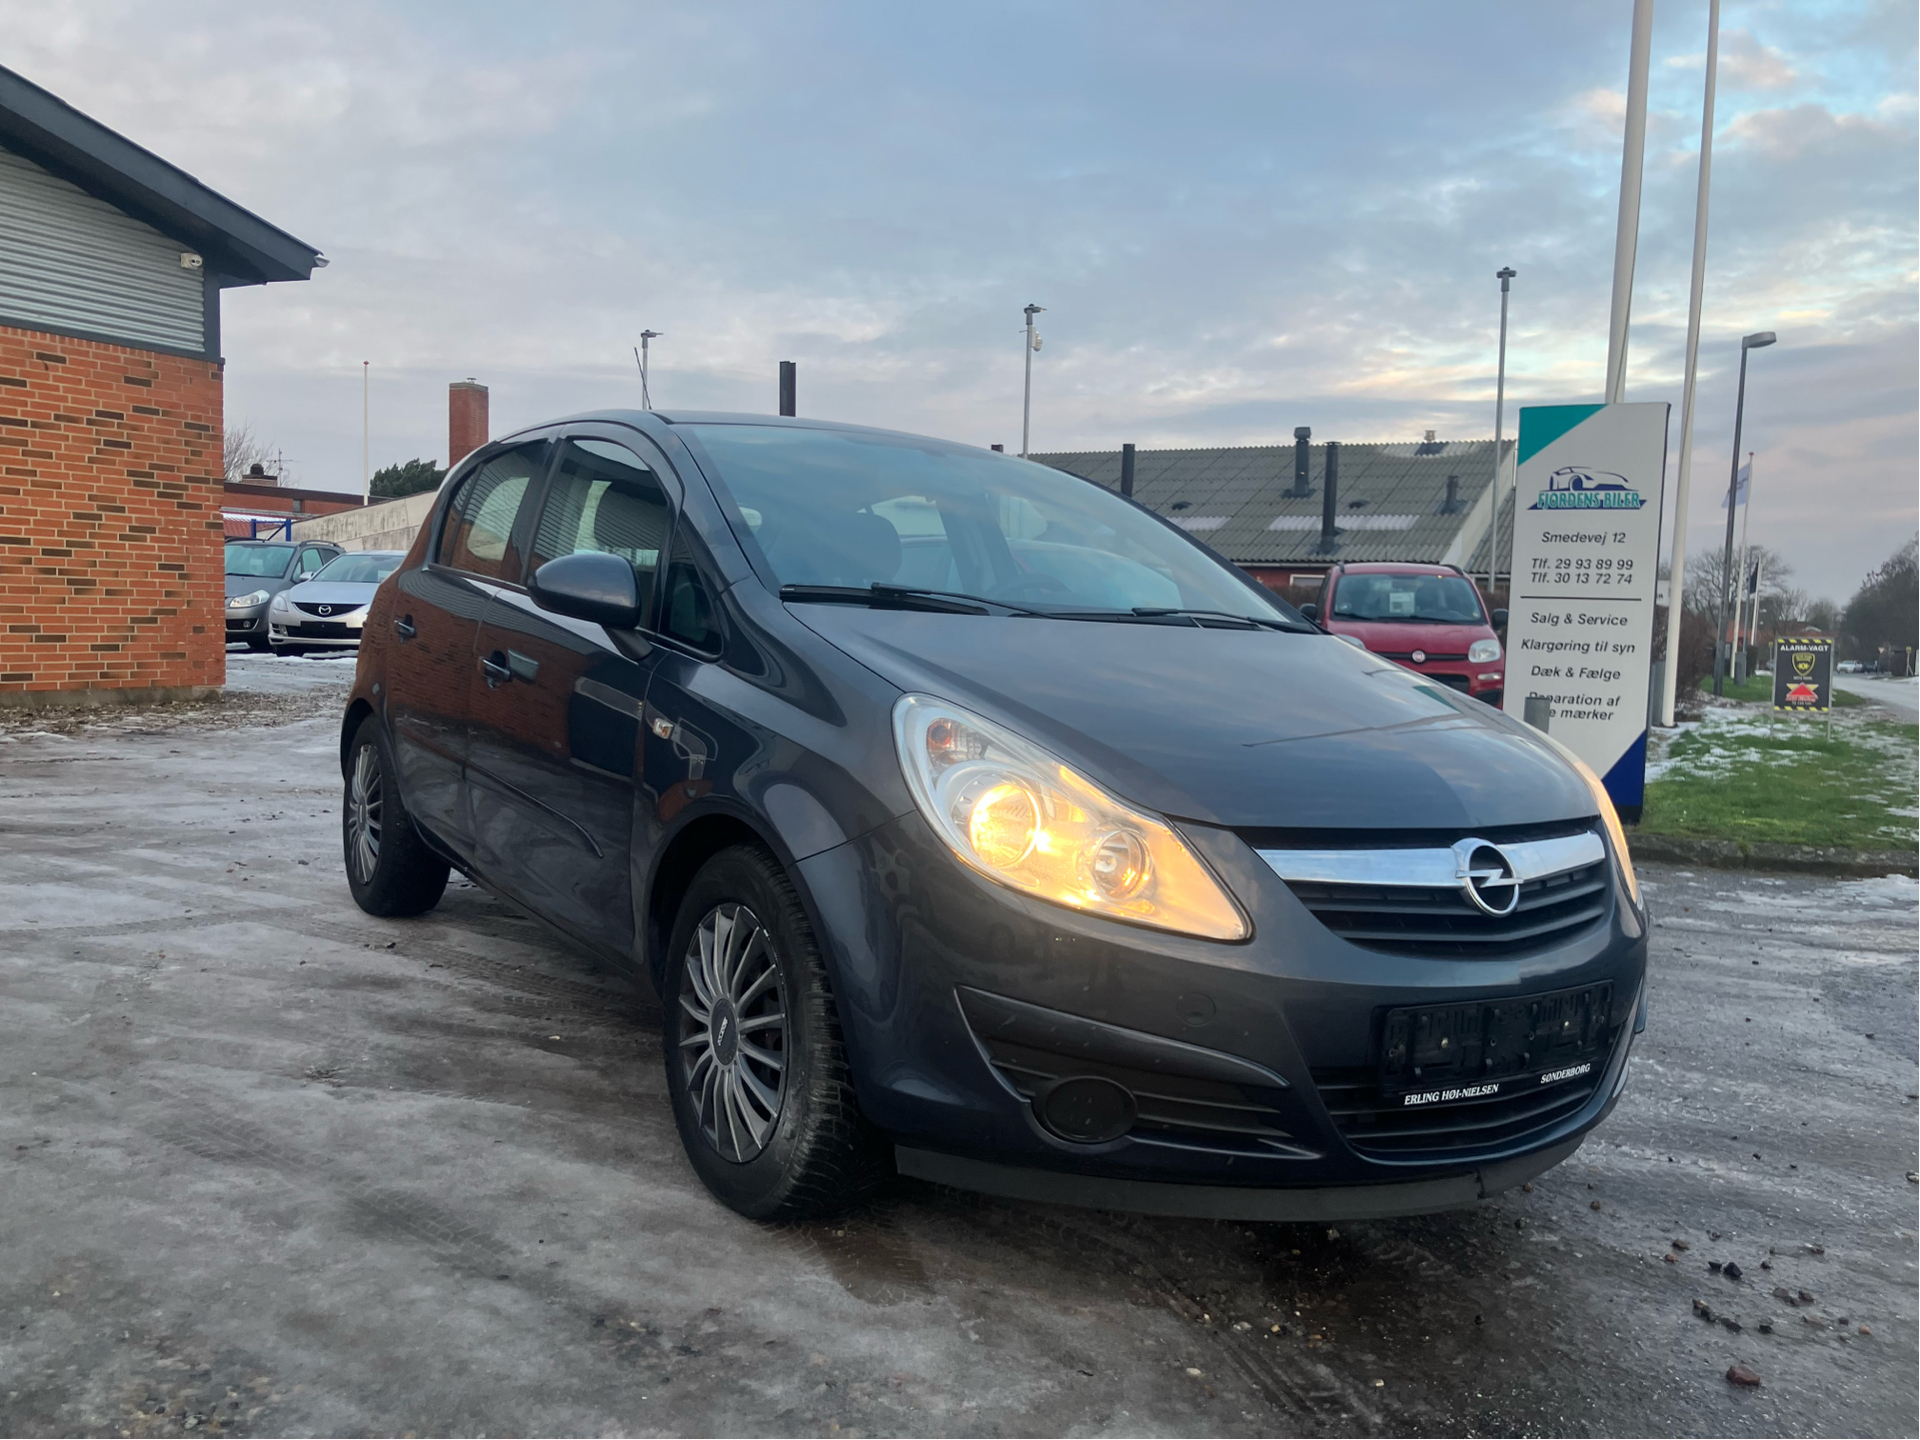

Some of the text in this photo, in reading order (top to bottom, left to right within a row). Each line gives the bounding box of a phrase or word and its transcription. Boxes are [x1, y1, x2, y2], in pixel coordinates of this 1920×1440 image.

[1537, 492, 1641, 510] FJORDENS BILER
[1541, 531, 1626, 546] Smedevej 12
[1531, 558, 1634, 571] Tlf. 29 93 89 99
[1531, 572, 1633, 585] Tlf. 30 13 72 74
[1530, 612, 1628, 626] Salg & Service
[1521, 638, 1636, 655] Klargøring til syn
[1531, 665, 1621, 682] Dæk & Fælge
[1606, 695, 1620, 707] af
[1560, 709, 1614, 720] mærker
[1404, 1083, 1499, 1106] ERLING HØI-NIELSEN
